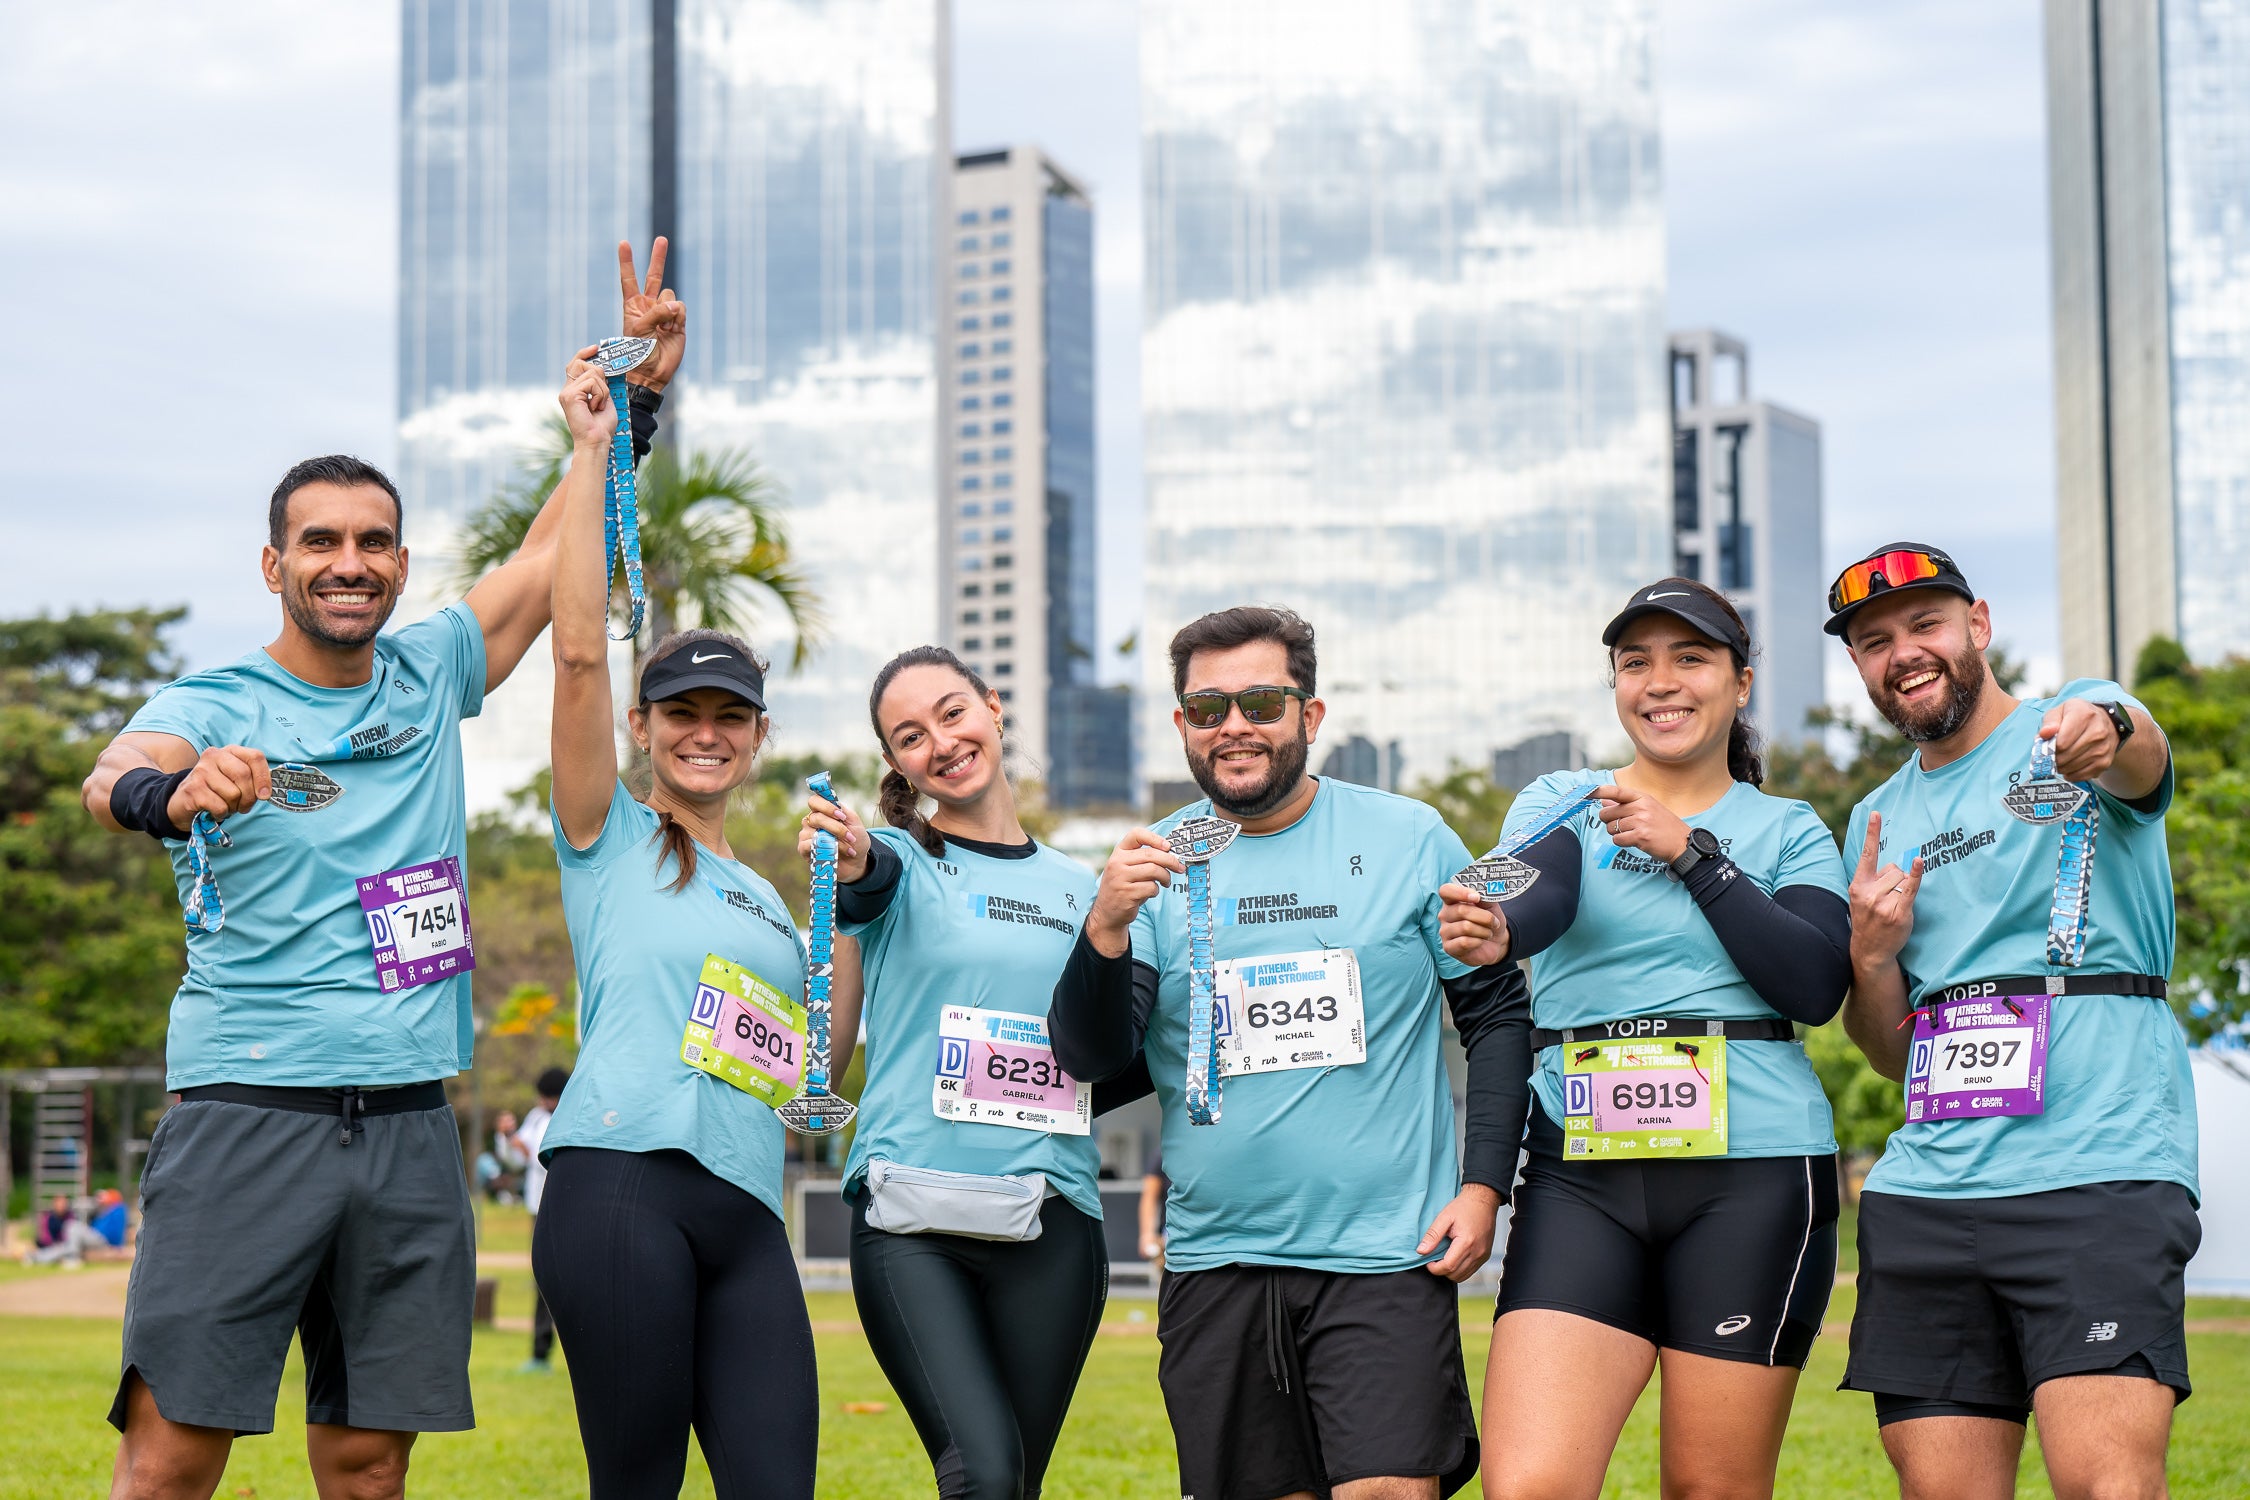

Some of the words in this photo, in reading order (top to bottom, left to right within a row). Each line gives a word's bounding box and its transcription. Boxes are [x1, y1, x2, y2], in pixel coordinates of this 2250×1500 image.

[2034, 802, 2054, 817] 18K
[1921, 828, 1964, 858] ATHENAS
[1922, 855, 1942, 875] RUN
[1940, 830, 1996, 864] STRONGER
[1612, 860, 1641, 871] RUN
[2055, 820, 2086, 914] ATHENAS
[403, 869, 434, 885] ATHENAS
[406, 882, 422, 896] RUN
[1486, 881, 1506, 894] 12K
[988, 896, 1042, 915] ATHENAS
[1238, 893, 1298, 910] ATHENAS
[403, 902, 457, 938] 7454
[811, 862, 834, 965] STRONGER
[1238, 911, 1266, 925] RUN
[1268, 904, 1338, 924] STRONGER
[371, 914, 388, 944] D
[989, 908, 1014, 922] RUN
[1016, 914, 1075, 937] STRONGER
[431, 939, 447, 949] FABIO
[376, 950, 397, 964] 18K
[1258, 962, 1298, 975] ATHENAS
[1258, 976, 1278, 987] RUN
[1278, 970, 1326, 984] STRONGER
[754, 979, 781, 1004] ATHENAS
[809, 975, 830, 1003] 6K
[1943, 982, 1997, 1003] YOPP
[697, 990, 715, 1020] D
[751, 991, 766, 1008] RUN
[765, 1000, 794, 1027] STRONGER
[1191, 972, 1212, 1054] ATHENAS
[1247, 996, 1338, 1029] 6343
[1956, 1003, 1993, 1016] ATHENAS
[1002, 1018, 1041, 1033] ATHENAS
[1604, 1020, 1668, 1038] YOPP
[1956, 1016, 1971, 1028] RUN
[1971, 1014, 2018, 1026] STRONGER
[688, 1025, 710, 1040] 12K
[735, 1014, 794, 1066] 6901
[1001, 1030, 1019, 1042] RUN
[1275, 1032, 1315, 1042] MICHAEL
[945, 1042, 962, 1071] D
[1622, 1044, 1662, 1056] ATHENAS
[1944, 1040, 2021, 1071] 7397
[750, 1054, 772, 1069] JOYCE
[1643, 1054, 1690, 1067] STRONGER
[1916, 1044, 1928, 1074] D
[987, 1054, 1065, 1090] 6231
[1964, 1076, 1993, 1084] BRUNO
[940, 1079, 958, 1092] 6K
[1910, 1081, 1928, 1095] 18K
[1002, 1089, 1045, 1102] GABRIELA
[1571, 1080, 1586, 1110] D
[1612, 1082, 1697, 1110] 6919
[1568, 1118, 1590, 1130] 12K
[1637, 1116, 1672, 1125] KARINA
